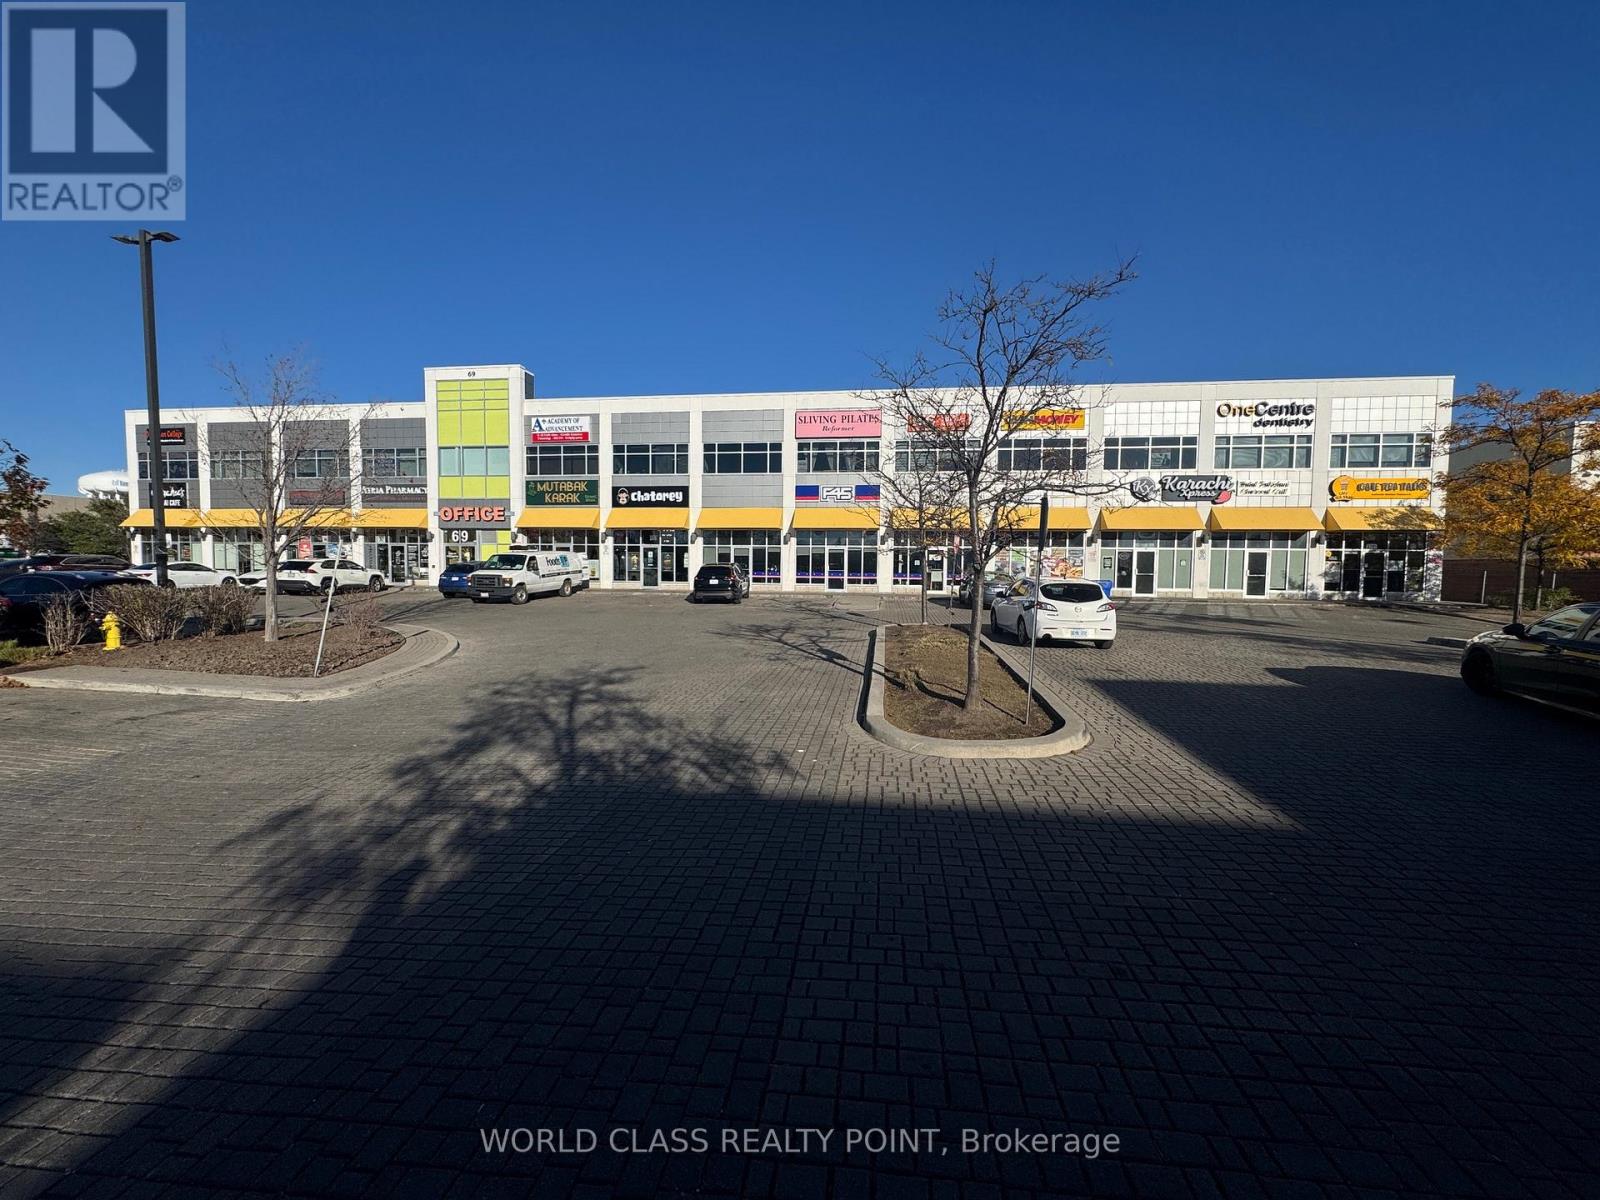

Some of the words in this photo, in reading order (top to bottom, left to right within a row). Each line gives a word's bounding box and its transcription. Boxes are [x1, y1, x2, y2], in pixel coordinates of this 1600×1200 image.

[798, 415, 836, 424] SLIVING
[841, 414, 880, 423] PILATES
[1253, 418, 1313, 428] dentistry
[537, 481, 588, 491] MUTABAK
[1162, 476, 1234, 492] Karachi
[385, 485, 428, 494] PHARMACY
[1180, 489, 1216, 500] Xpress
[544, 493, 580, 503] KARAK
[440, 507, 505, 522] OFFICE
[452, 530, 468, 542] 69
